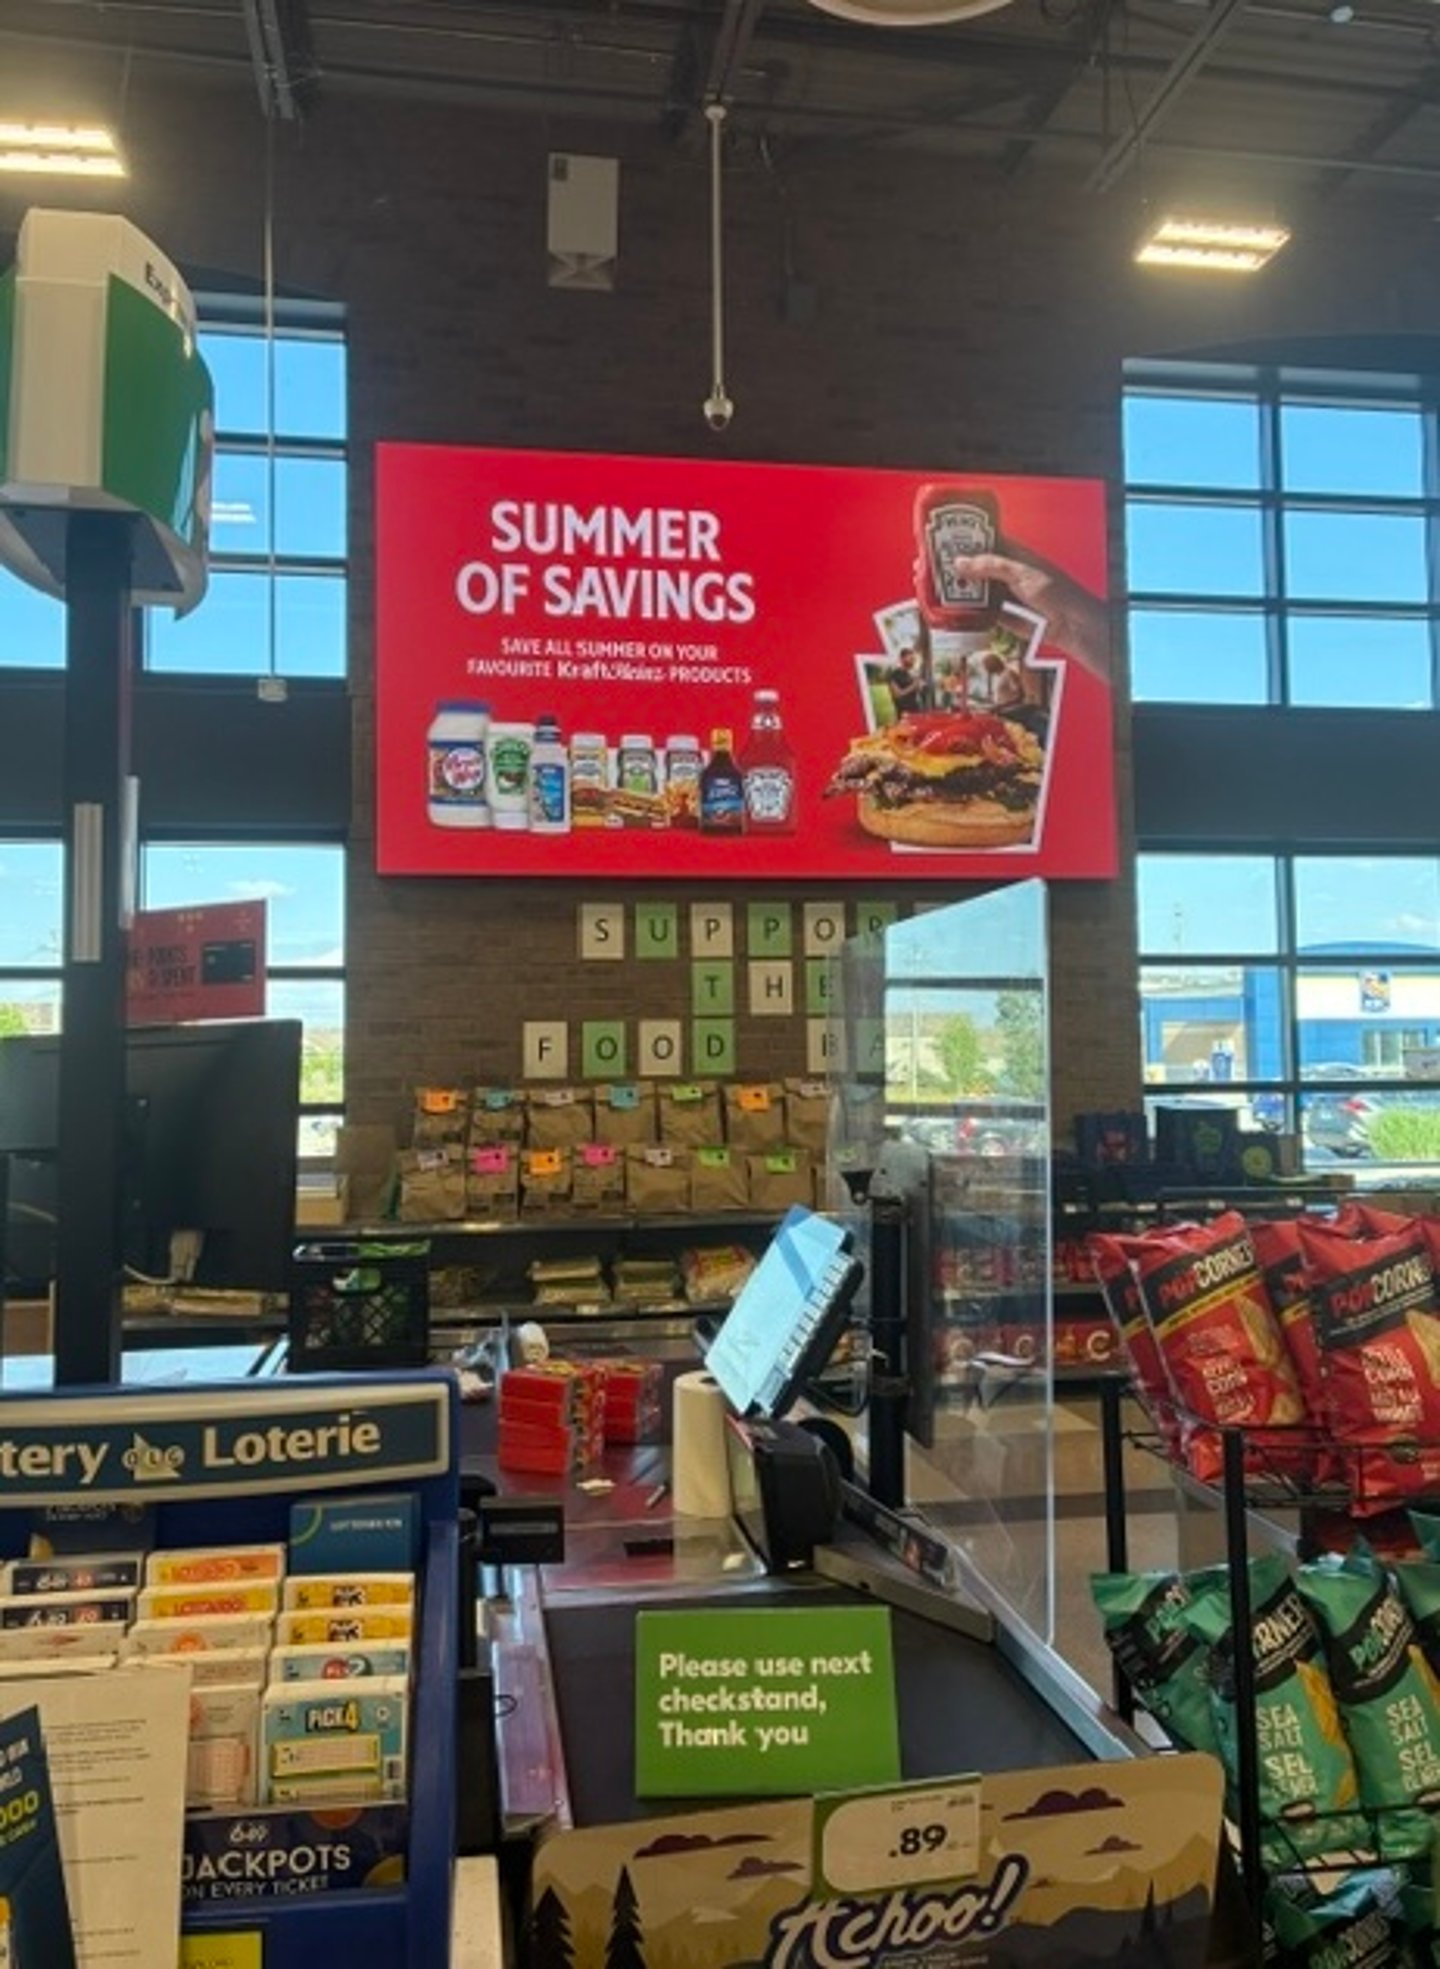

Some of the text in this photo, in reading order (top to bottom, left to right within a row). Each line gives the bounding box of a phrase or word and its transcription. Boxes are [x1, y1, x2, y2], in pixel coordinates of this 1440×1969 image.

[491, 500, 721, 561] SUMMER
[456, 561, 756, 623] OF SAVINGS
[501, 637, 718, 662] SAVE ALL SUMMER ON YOUR
[467, 658, 551, 677] FAVOURITE
[669, 666, 752, 684] PRODUCTS
[537, 1032, 725, 1062] FOOD
[203, 1412, 382, 1468] Loterie
[659, 1650, 873, 1679] Please use next
[657, 1684, 828, 1716] checkstand,
[657, 1719, 809, 1753] Thank you
[1264, 1753, 1313, 1781] SEL
[887, 1824, 948, 1859] .89
[181, 1845, 352, 1881] JACKPOTS
[210, 1881, 265, 1899] EVERY
[267, 1874, 330, 1896] TICKET
